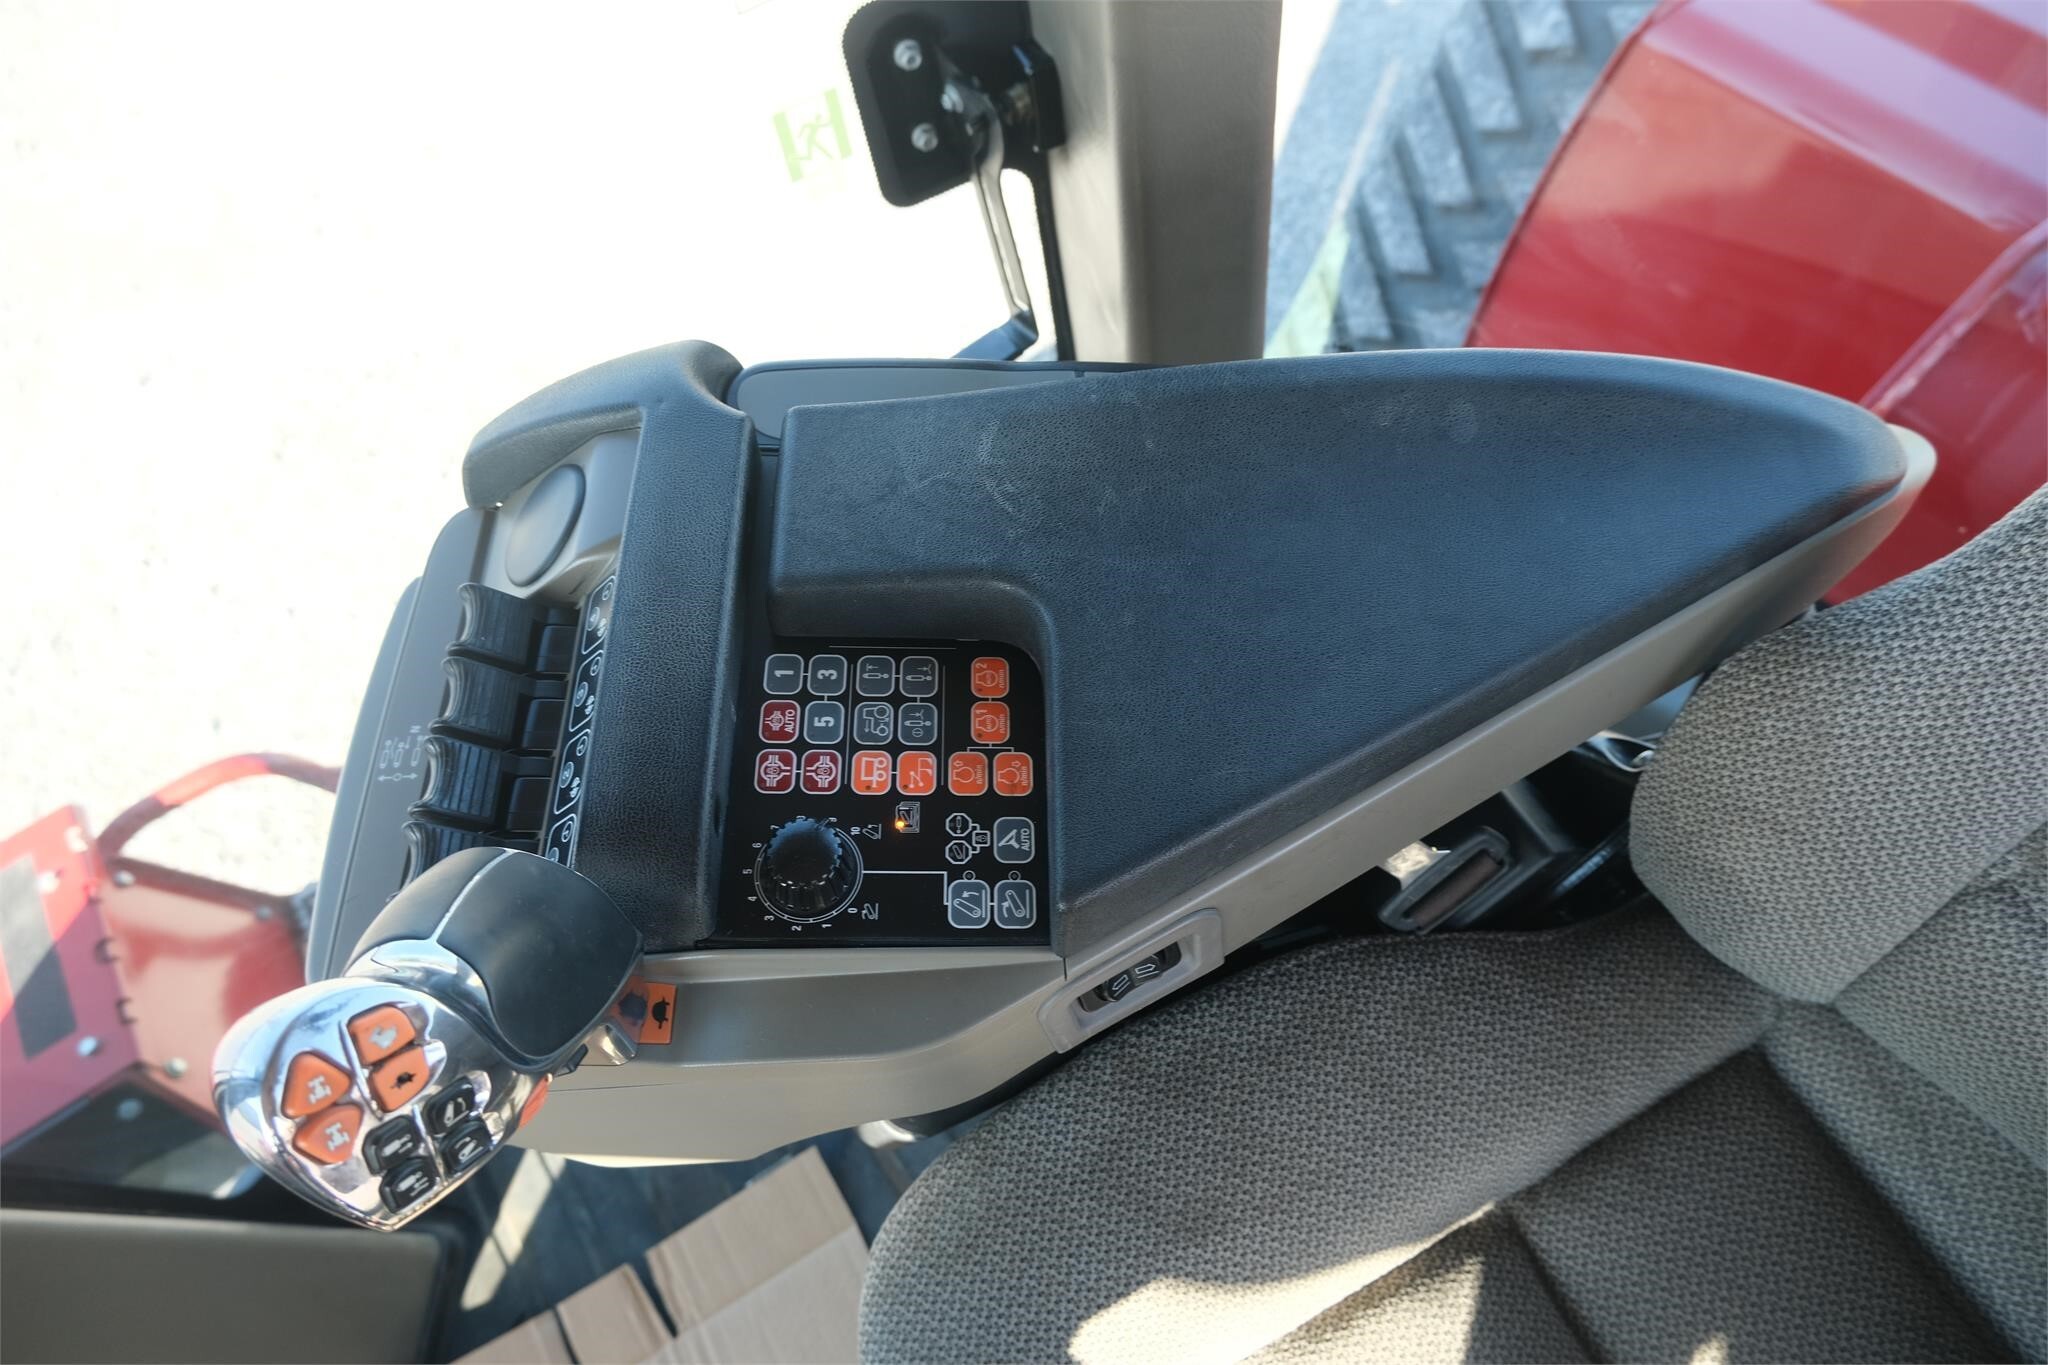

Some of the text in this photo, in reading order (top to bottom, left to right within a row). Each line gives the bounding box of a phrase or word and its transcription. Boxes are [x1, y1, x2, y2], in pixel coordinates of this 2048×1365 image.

[975, 662, 987, 670] 2
[774, 670, 795, 678] 1
[817, 669, 837, 680] 3
[784, 709, 796, 733] AUTO
[814, 716, 834, 727] 5
[975, 764, 983, 785] n/min
[1020, 765, 1028, 786] n/min
[850, 826, 860, 836] 10
[1020, 827, 1031, 851] AUTO
